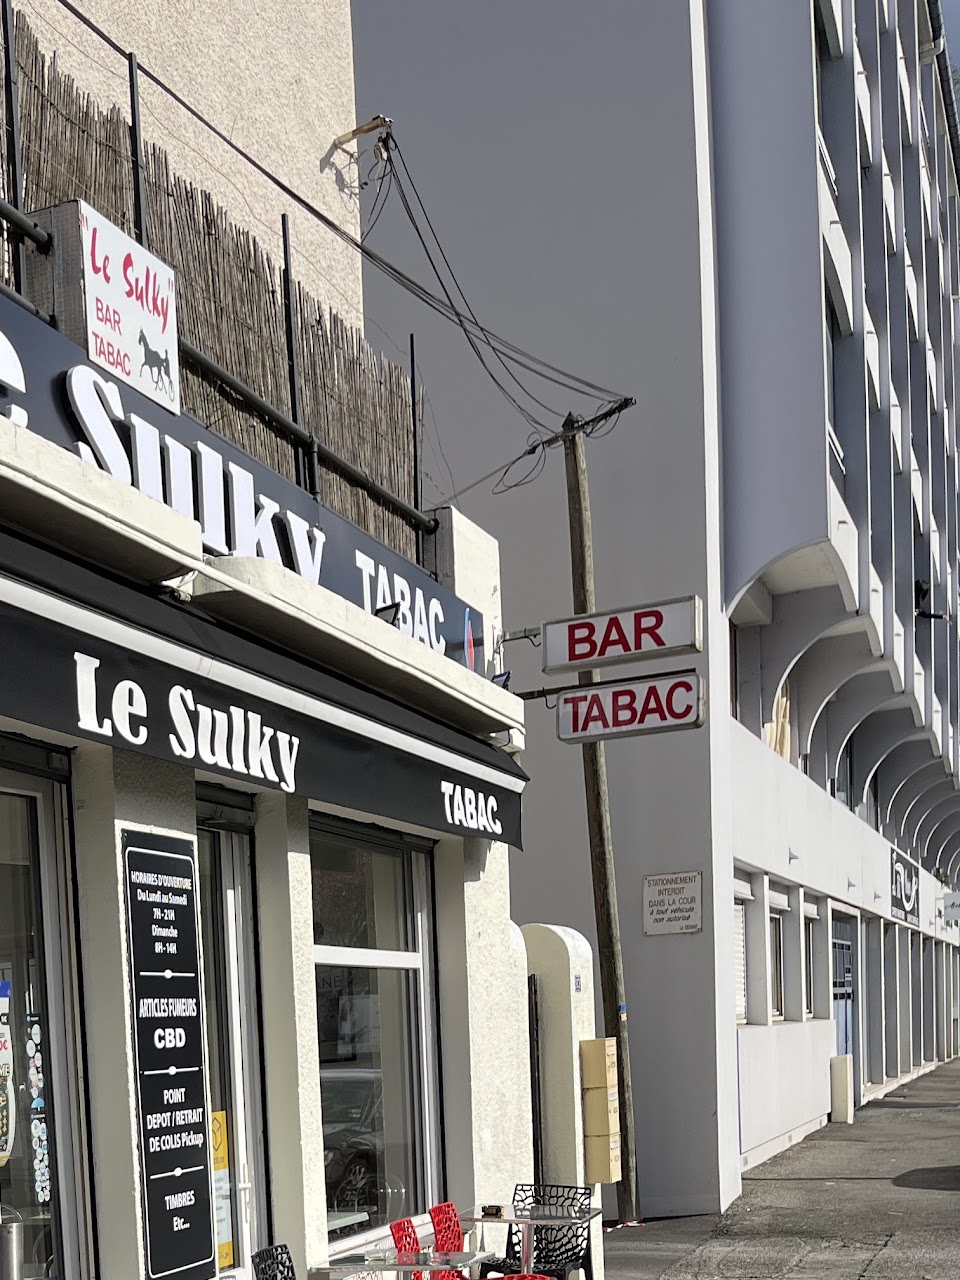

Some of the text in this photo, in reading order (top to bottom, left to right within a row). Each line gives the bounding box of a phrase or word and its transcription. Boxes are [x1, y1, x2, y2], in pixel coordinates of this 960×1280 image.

[96, 297, 122, 336] BAR
[92, 331, 131, 377] TABAC
[66, 364, 326, 585] Sulky
[355, 549, 446, 657] TABAC
[568, 610, 667, 662] BAR
[564, 680, 693, 733] TABAC
[73, 652, 300, 793] Le Sulky
[441, 781, 503, 835] TABAC
[131, 870, 192, 890] HORAIRES D'OUVERTURE
[647, 875, 697, 888] STATIONNEMENT
[136, 888, 188, 905] Du Lundi au Samedi
[648, 896, 697, 908] DANS LA COUR
[657, 887, 686, 897] INTERDIT
[151, 924, 178, 938] Dimanche
[139, 997, 197, 1018] ARTICLES FUMEURS
[153, 1027, 186, 1049] CBD
[163, 1087, 186, 1105] POINT
[146, 1111, 171, 1130] DEPOT
[175, 1107, 204, 1126] RETRAIT
[149, 1130, 204, 1153] DE COLIS Pickup
[164, 1189, 196, 1211] TIMBRES
